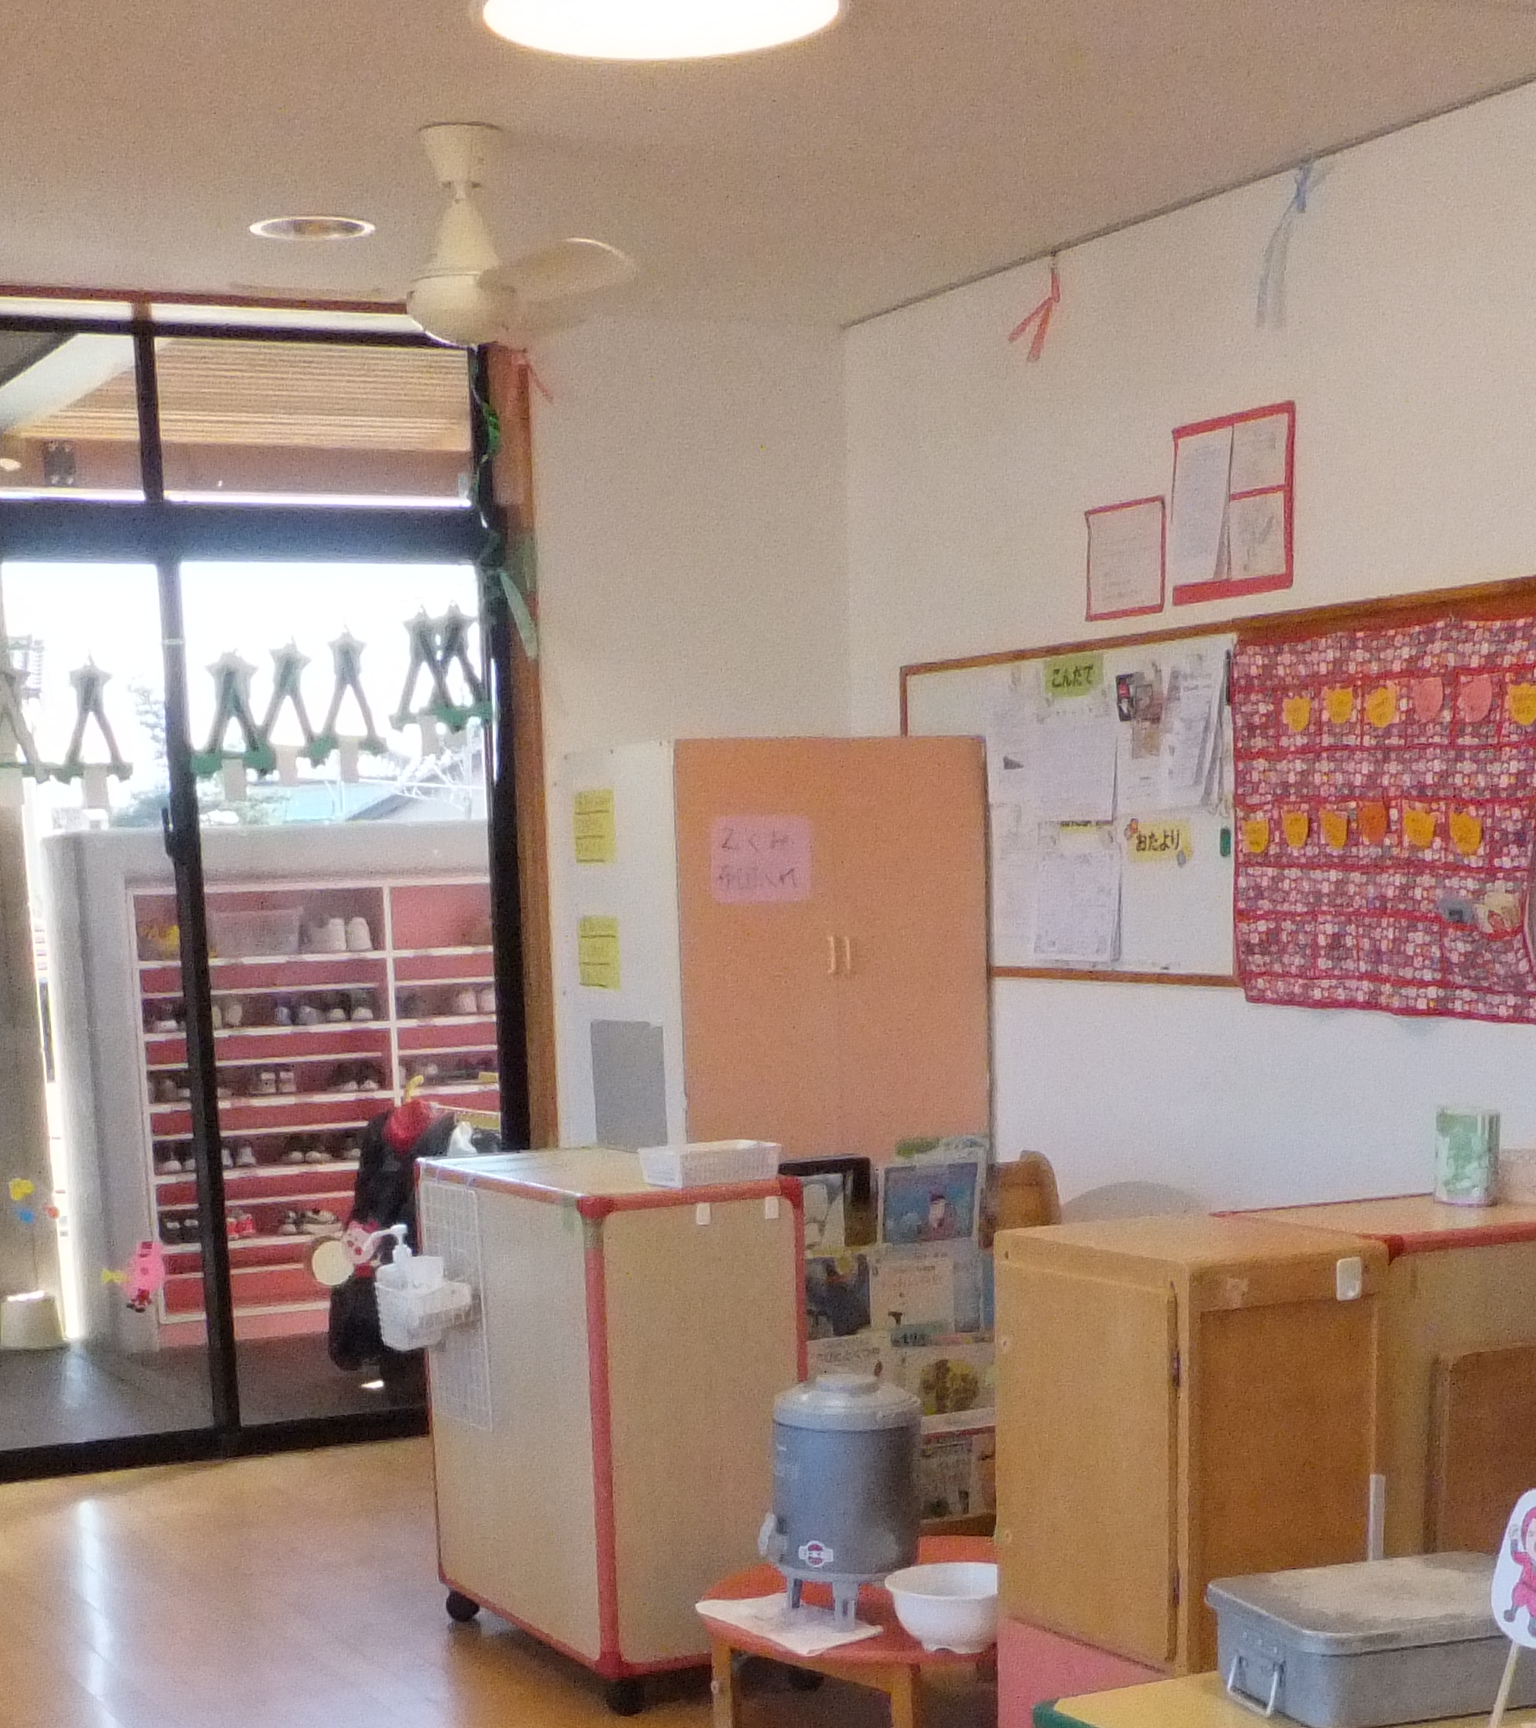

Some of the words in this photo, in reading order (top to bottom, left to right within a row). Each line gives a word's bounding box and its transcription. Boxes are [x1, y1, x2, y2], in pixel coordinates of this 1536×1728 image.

[1051, 664, 1094, 688] こんだて
[1136, 829, 1180, 852] おたより
